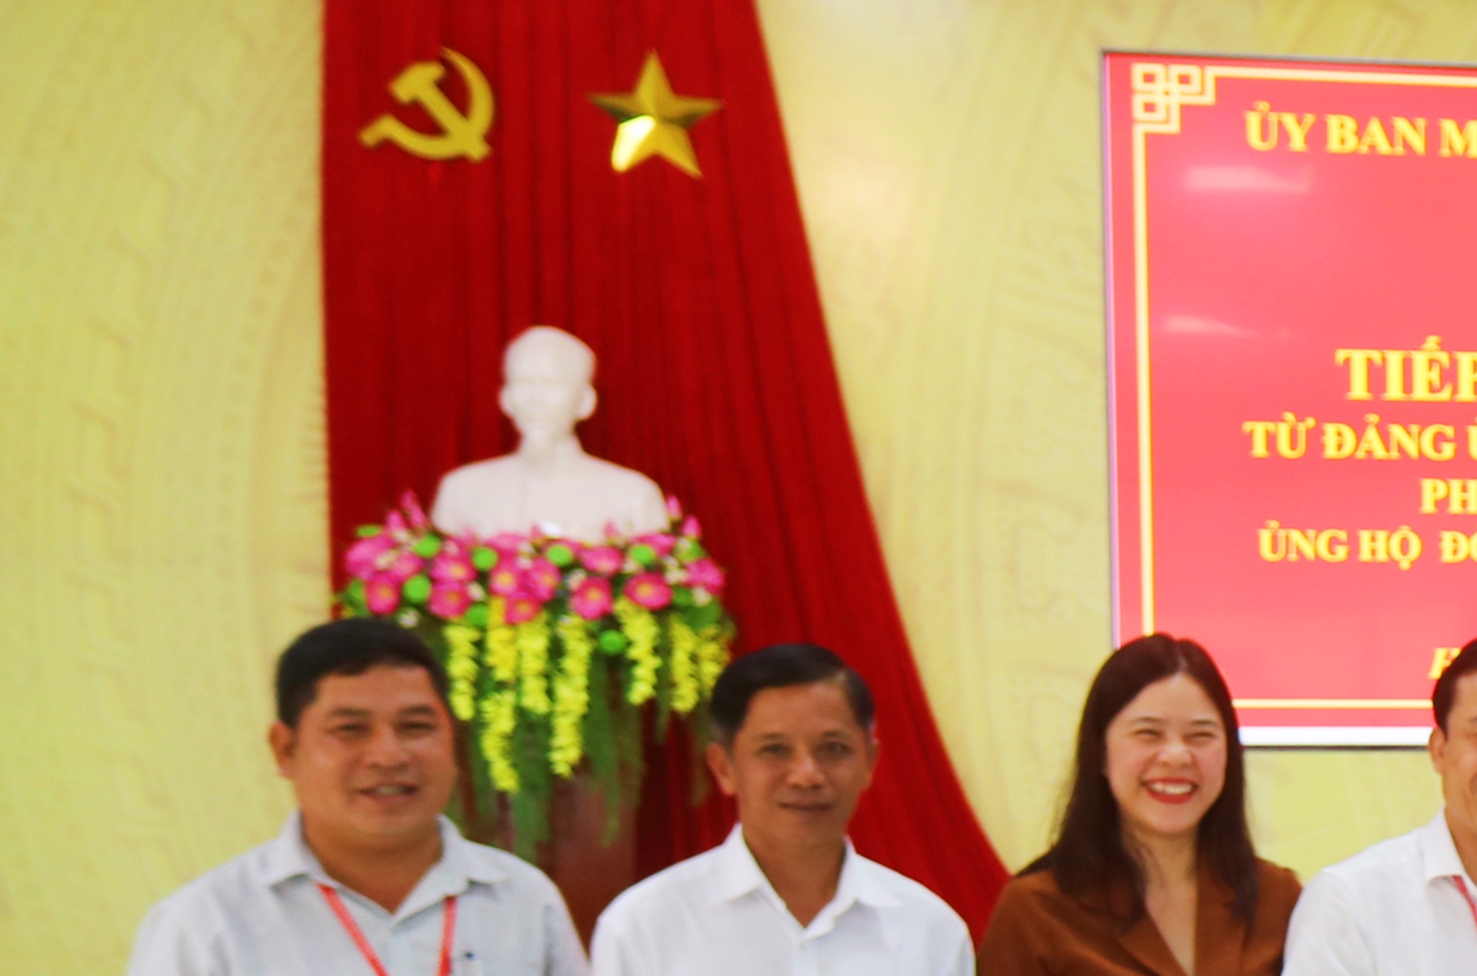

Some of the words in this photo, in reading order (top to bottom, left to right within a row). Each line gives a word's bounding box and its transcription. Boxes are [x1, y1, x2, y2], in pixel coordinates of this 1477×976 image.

[1245, 101, 1315, 152] ỦY
[1326, 114, 1426, 155] BAN
[1243, 416, 1315, 458] TỪ
[1322, 414, 1456, 460] ĐẢNG
[1258, 520, 1349, 562] ỦNG
[1358, 526, 1422, 570] HỘ
